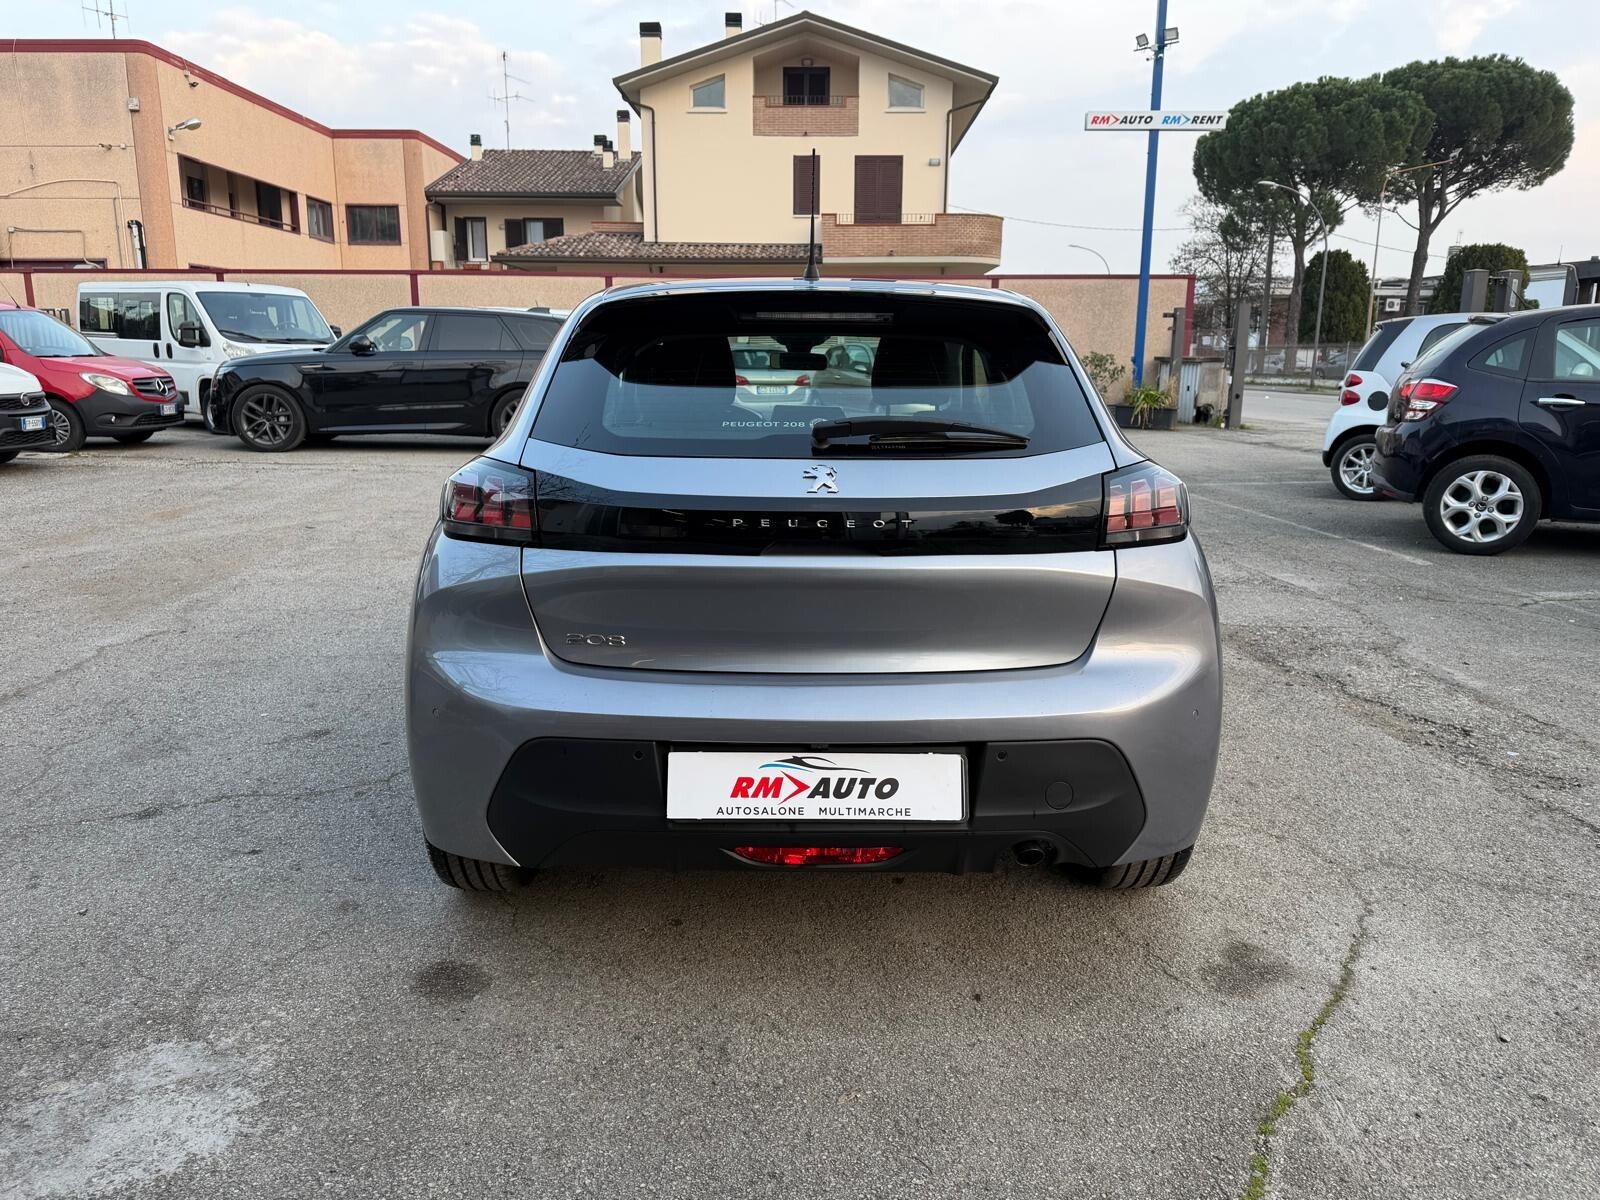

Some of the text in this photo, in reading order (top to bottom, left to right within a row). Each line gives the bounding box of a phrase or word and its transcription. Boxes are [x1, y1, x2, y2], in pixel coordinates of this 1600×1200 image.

[732, 518, 913, 528] PEUGEOT
[566, 633, 626, 646] 208
[716, 806, 912, 817] AUTOSALONE MULTIMARCHE
